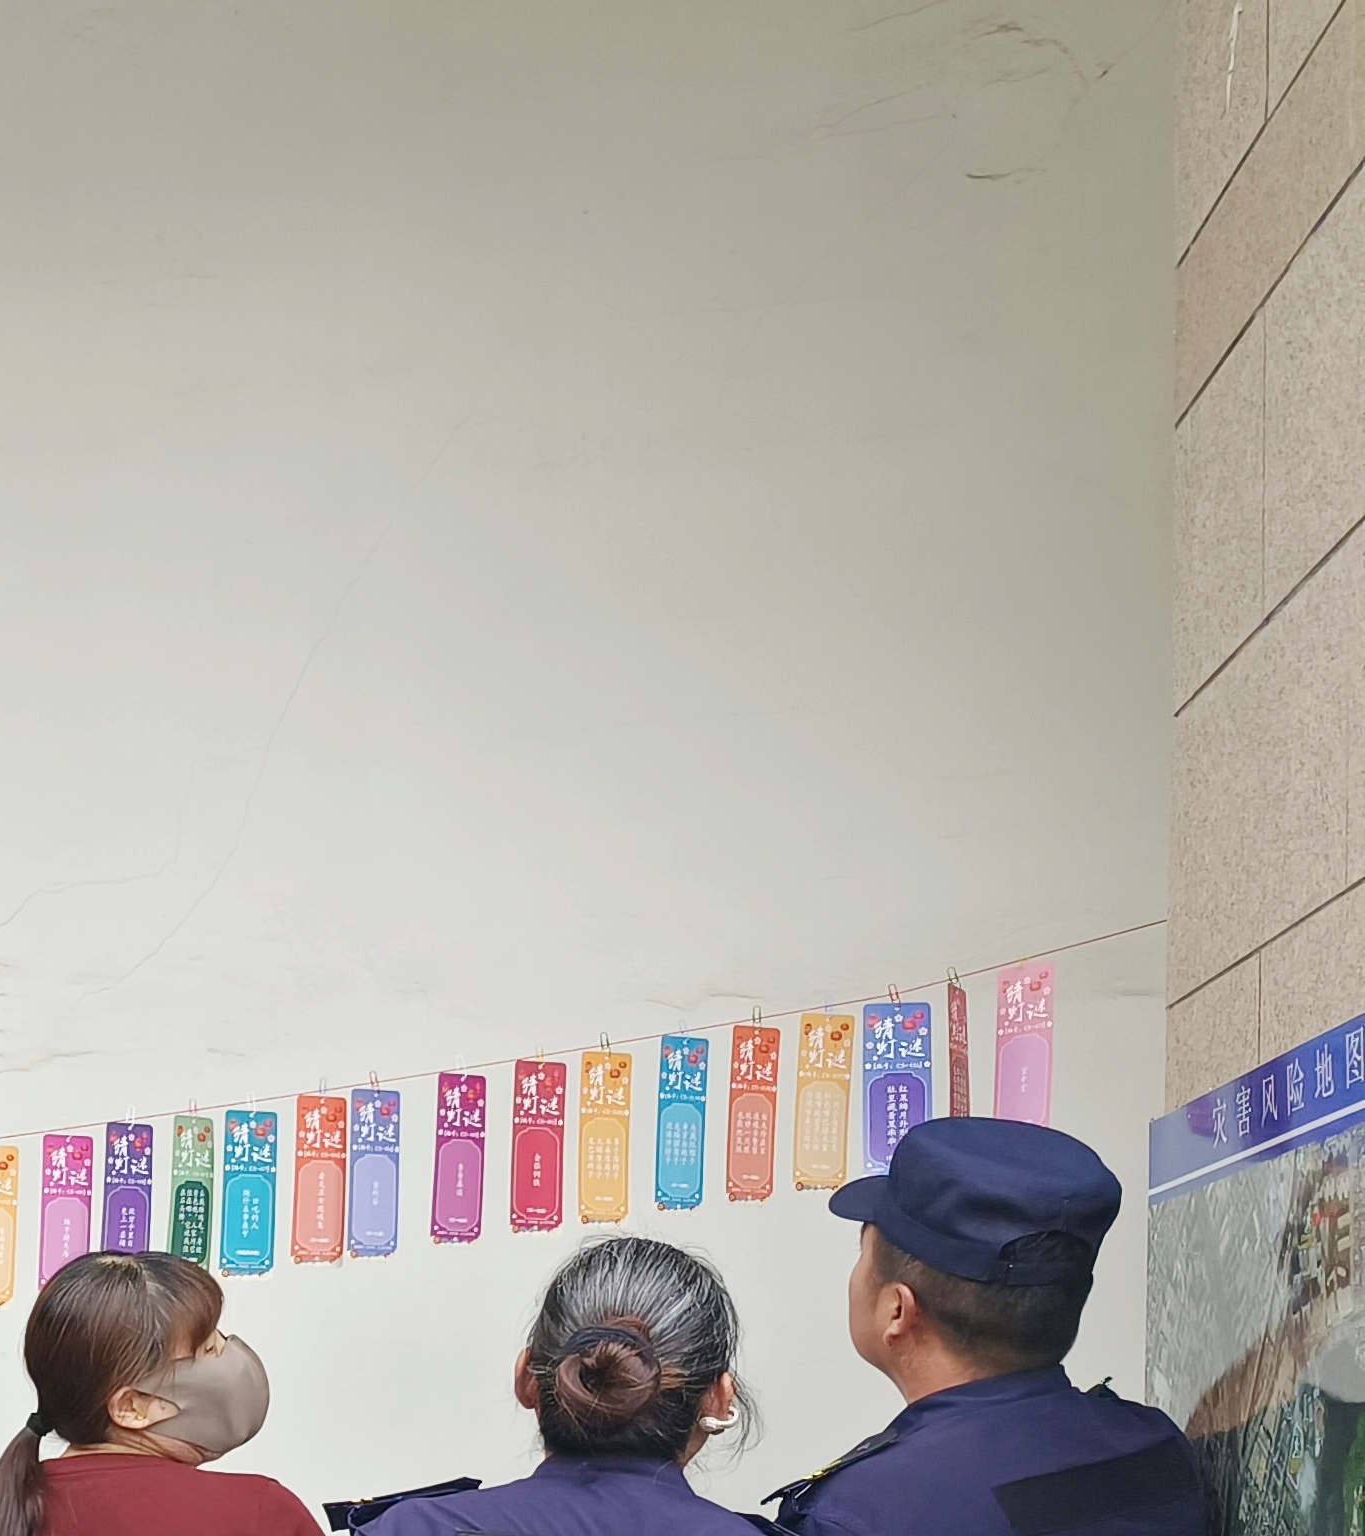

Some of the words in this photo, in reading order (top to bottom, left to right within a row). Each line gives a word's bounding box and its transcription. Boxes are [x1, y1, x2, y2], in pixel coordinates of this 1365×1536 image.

[1212, 1026, 1365, 1150] 灾害风险地图
